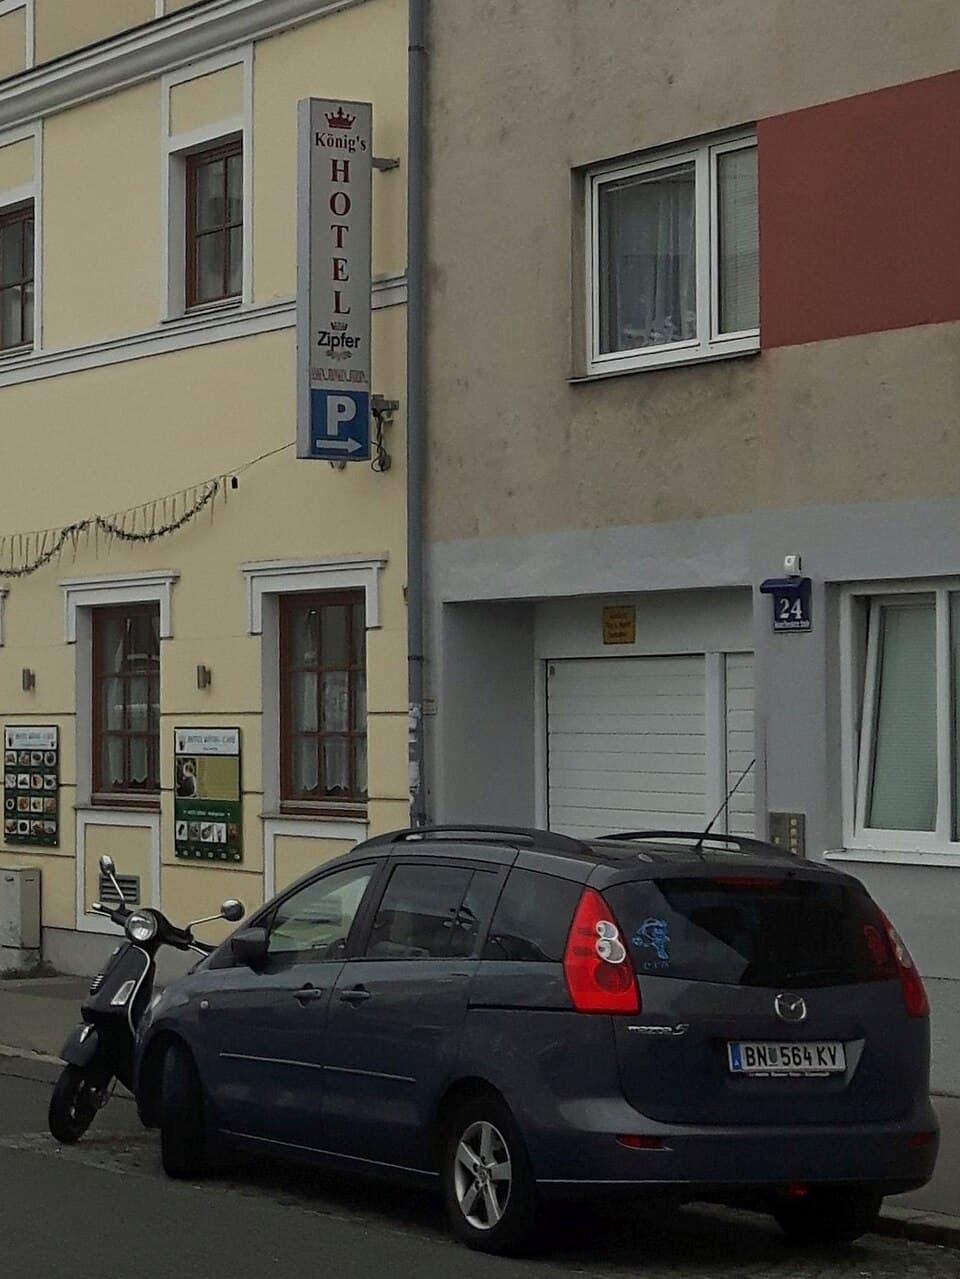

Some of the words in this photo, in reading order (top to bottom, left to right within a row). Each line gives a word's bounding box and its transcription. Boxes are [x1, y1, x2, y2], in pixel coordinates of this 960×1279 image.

[315, 131, 367, 153] König's
[329, 158, 351, 315] HOTEL
[317, 331, 361, 352] Zipfer
[326, 394, 357, 436] P
[780, 598, 802, 619] 24
[744, 1046, 767, 1067] BN
[780, 1046, 812, 1066] 564
[817, 1045, 838, 1066] KV
